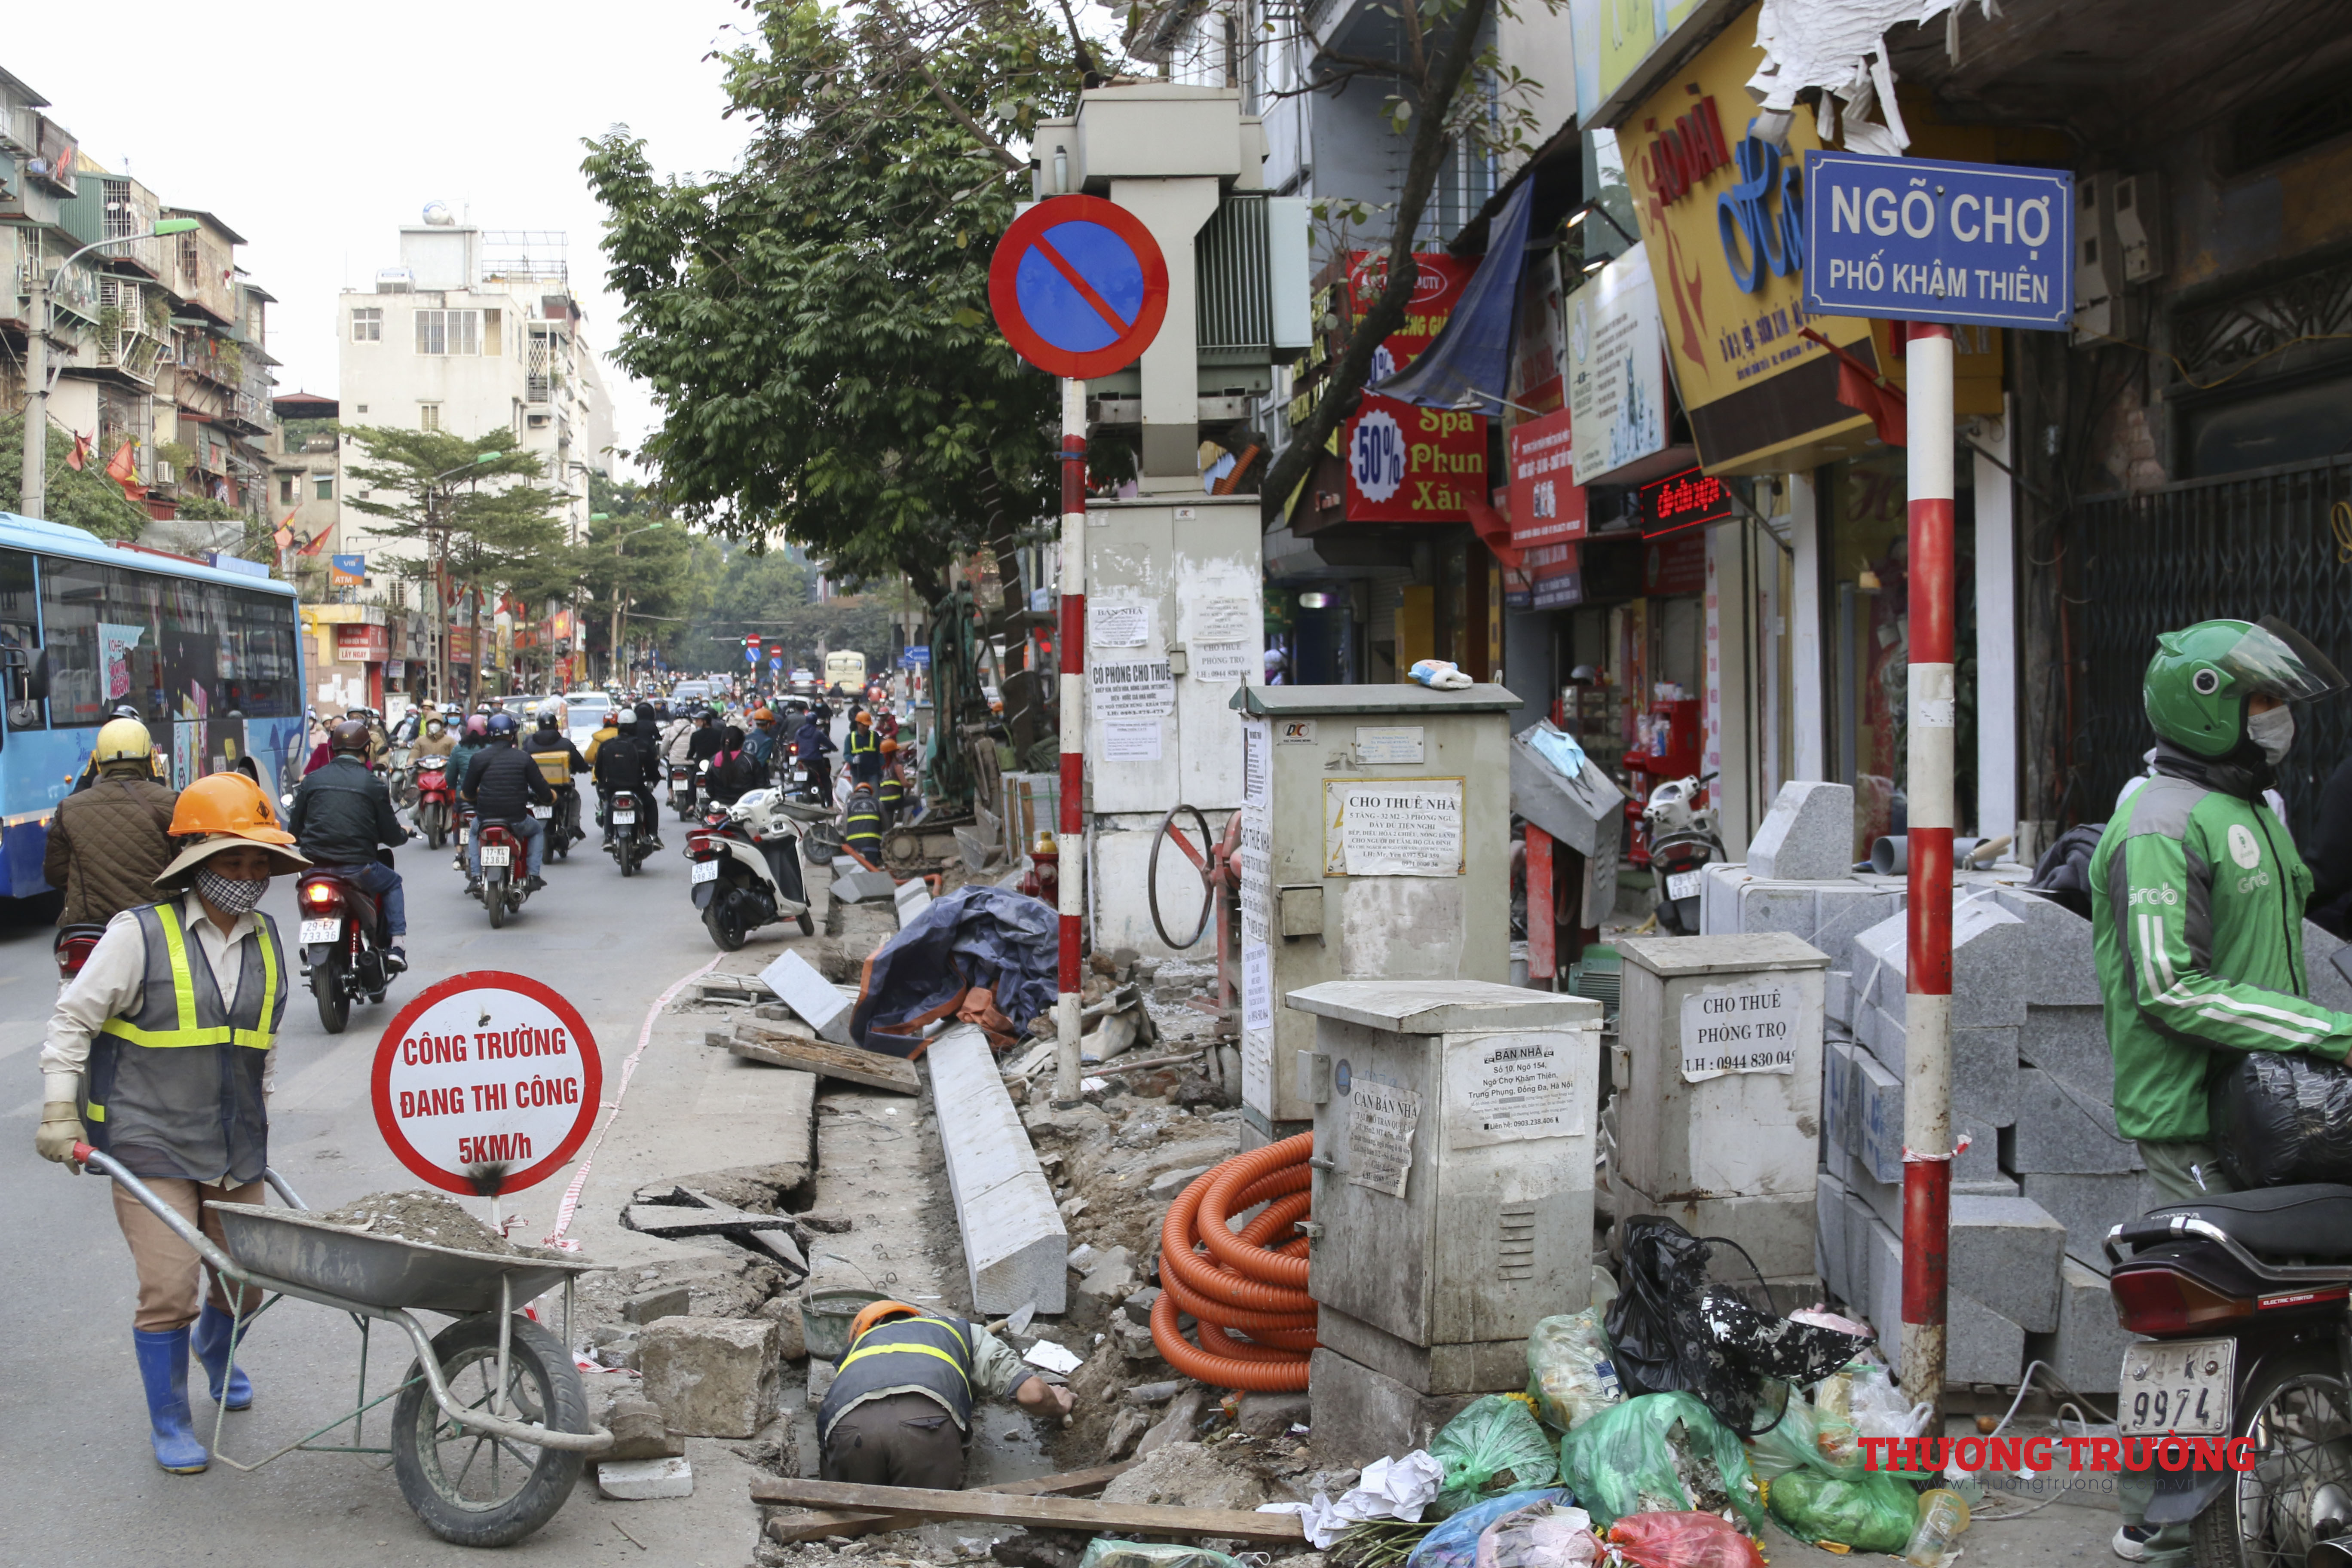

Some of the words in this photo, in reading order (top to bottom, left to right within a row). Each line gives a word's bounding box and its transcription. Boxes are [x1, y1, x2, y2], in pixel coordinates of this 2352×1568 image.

[1832, 178, 1935, 239] NGÕ
[1951, 193, 2050, 260] CHỢ
[1830, 249, 1884, 291] PHỐ
[1893, 259, 1966, 297] KHÂM
[1975, 266, 2048, 304] THIÊN
[1419, 407, 1474, 438] Spa
[1359, 425, 1400, 485] 50%
[1410, 444, 1482, 472] Phun
[1093, 664, 1103, 684] CÓ
[1105, 662, 1131, 683] PHÒNG
[1133, 665, 1148, 682] CHO
[1150, 660, 1170, 681] THUÊ
[1202, 656, 1227, 665] PHÒNG
[1229, 656, 1244, 665] TRỌ
[1350, 796, 1380, 808] CHO
[1384, 796, 1422, 809] THUÊ
[1427, 797, 1455, 810] NHÀ
[302, 931, 336, 942] 733.36
[306, 921, 334, 931] 29-E2
[1703, 998, 1735, 1014] CHO
[1740, 989, 1781, 1011] THUÊ
[403, 1032, 467, 1066] CÔNG
[474, 1023, 566, 1060] TRƯỜNG
[1698, 1023, 1751, 1044] PHÒNG
[1756, 1022, 1786, 1040] TRỌ
[1495, 1048, 1517, 1060] BÁN
[1520, 1045, 1543, 1057] NHÀ
[1685, 1058, 1706, 1072] LH
[1717, 1055, 1746, 1069] 0944
[1751, 1052, 1773, 1067] 830
[1493, 1065, 1503, 1073] Số
[1517, 1063, 1531, 1072] Ngõ
[1468, 1091, 1489, 1099] Trung
[1491, 1089, 1516, 1097] Phụng,
[1483, 1078, 1497, 1087] Ngõ
[399, 1087, 465, 1118] ĐANG
[471, 1083, 507, 1112] THI
[515, 1074, 578, 1109] CÔNG
[1354, 1089, 1373, 1109] CẦN
[1375, 1094, 1394, 1114] BÁN
[1397, 1100, 1417, 1119] NHÀ
[1514, 1117, 1554, 1127] 0903.238.406
[459, 1133, 532, 1164] 5KM/h
[2133, 1387, 2209, 1427] 9974
